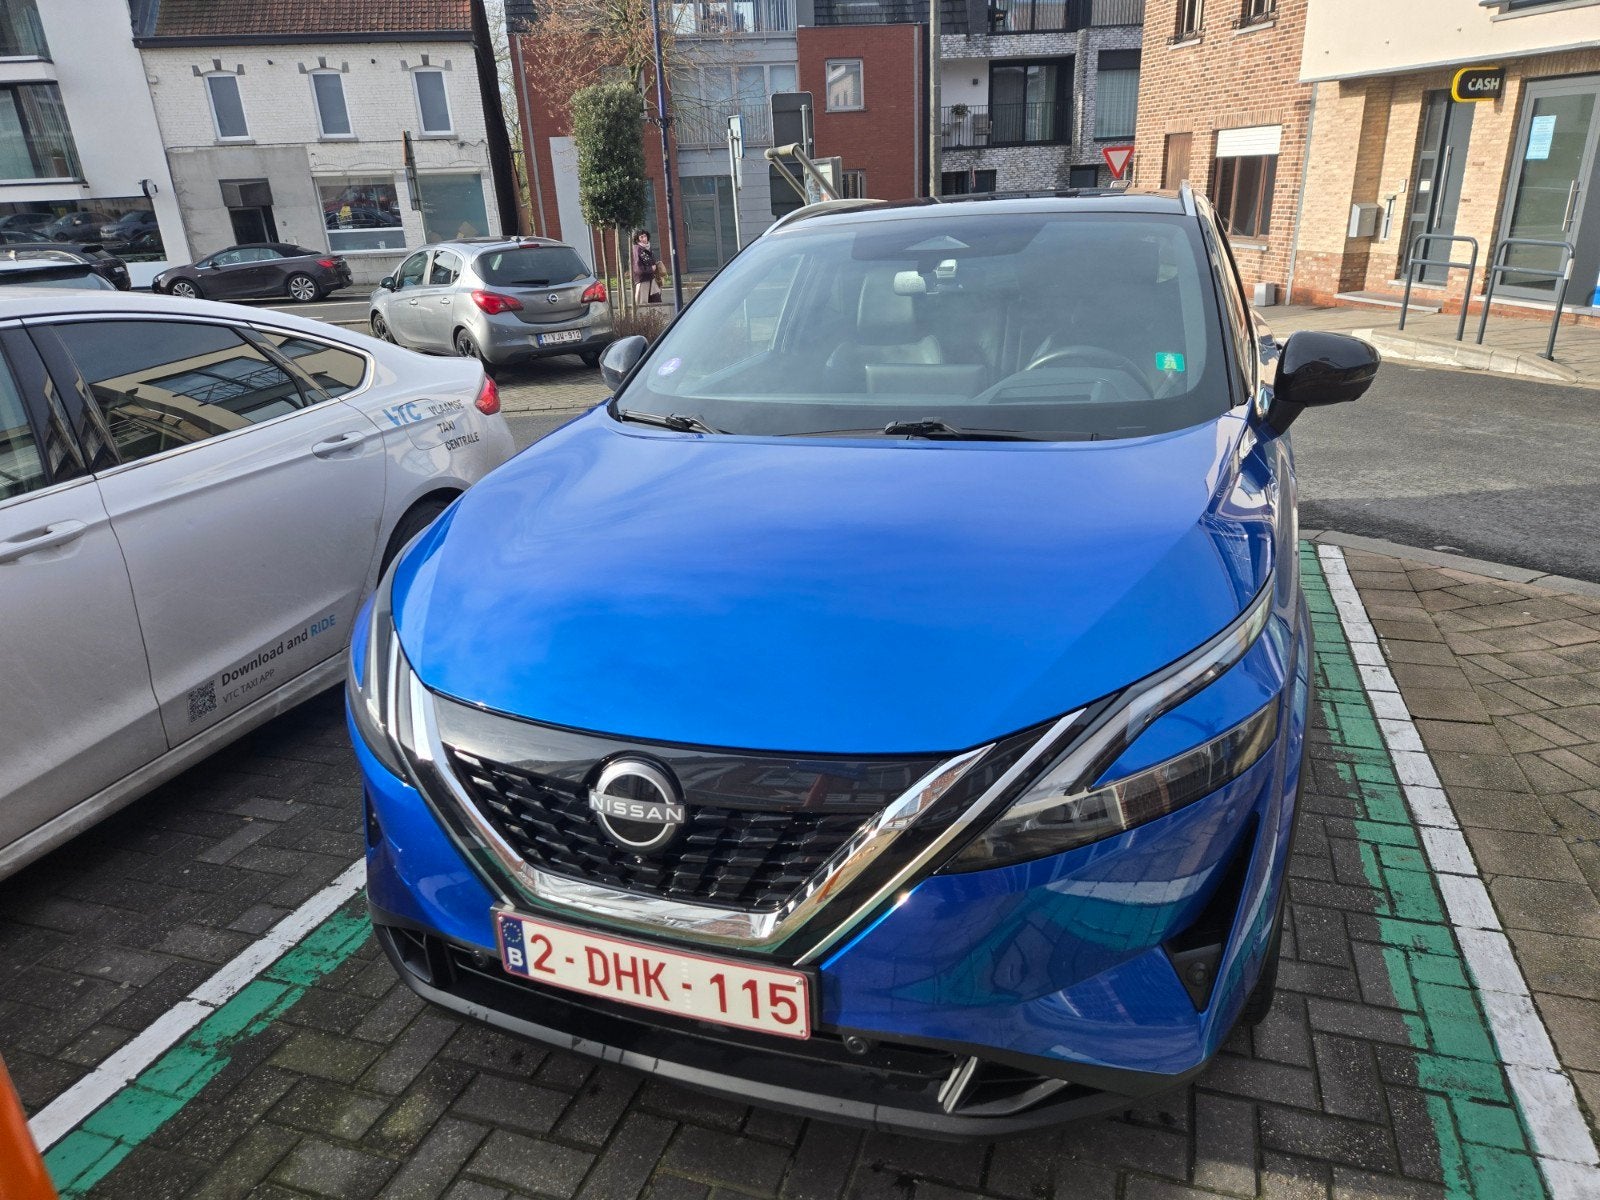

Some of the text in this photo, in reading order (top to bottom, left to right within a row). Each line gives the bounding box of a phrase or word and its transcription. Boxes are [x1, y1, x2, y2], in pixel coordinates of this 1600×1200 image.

[1468, 77, 1500, 91] CASH
[382, 402, 422, 427] VTC
[428, 399, 465, 416] VLAAMSE
[437, 420, 456, 434] TAXI
[445, 432, 480, 451] CENTRALE
[221, 614, 337, 687] Download and RIDE
[222, 668, 275, 704] VTC TAXI APP
[590, 794, 682, 821] NISSAN
[508, 946, 524, 967] B
